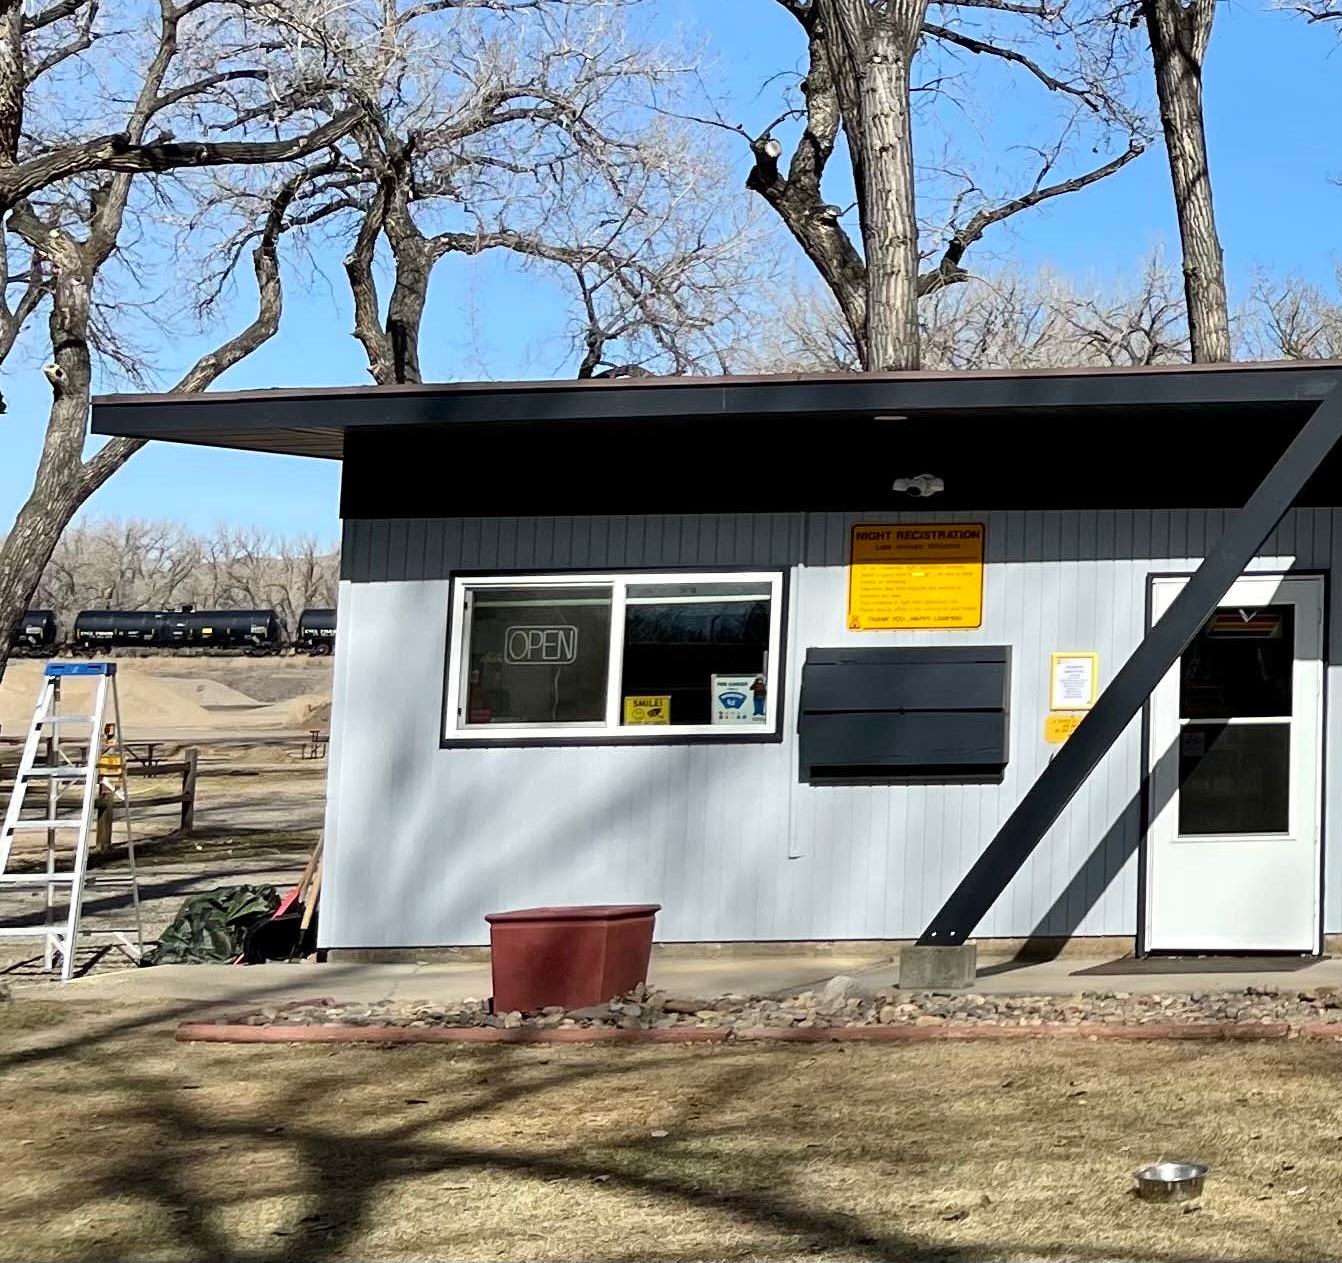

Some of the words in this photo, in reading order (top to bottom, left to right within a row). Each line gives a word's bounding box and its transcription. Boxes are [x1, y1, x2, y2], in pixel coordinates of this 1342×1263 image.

[856, 531, 892, 541] NIGHT
[896, 530, 980, 540] REGISTRATION
[509, 630, 574, 660] OPEN
